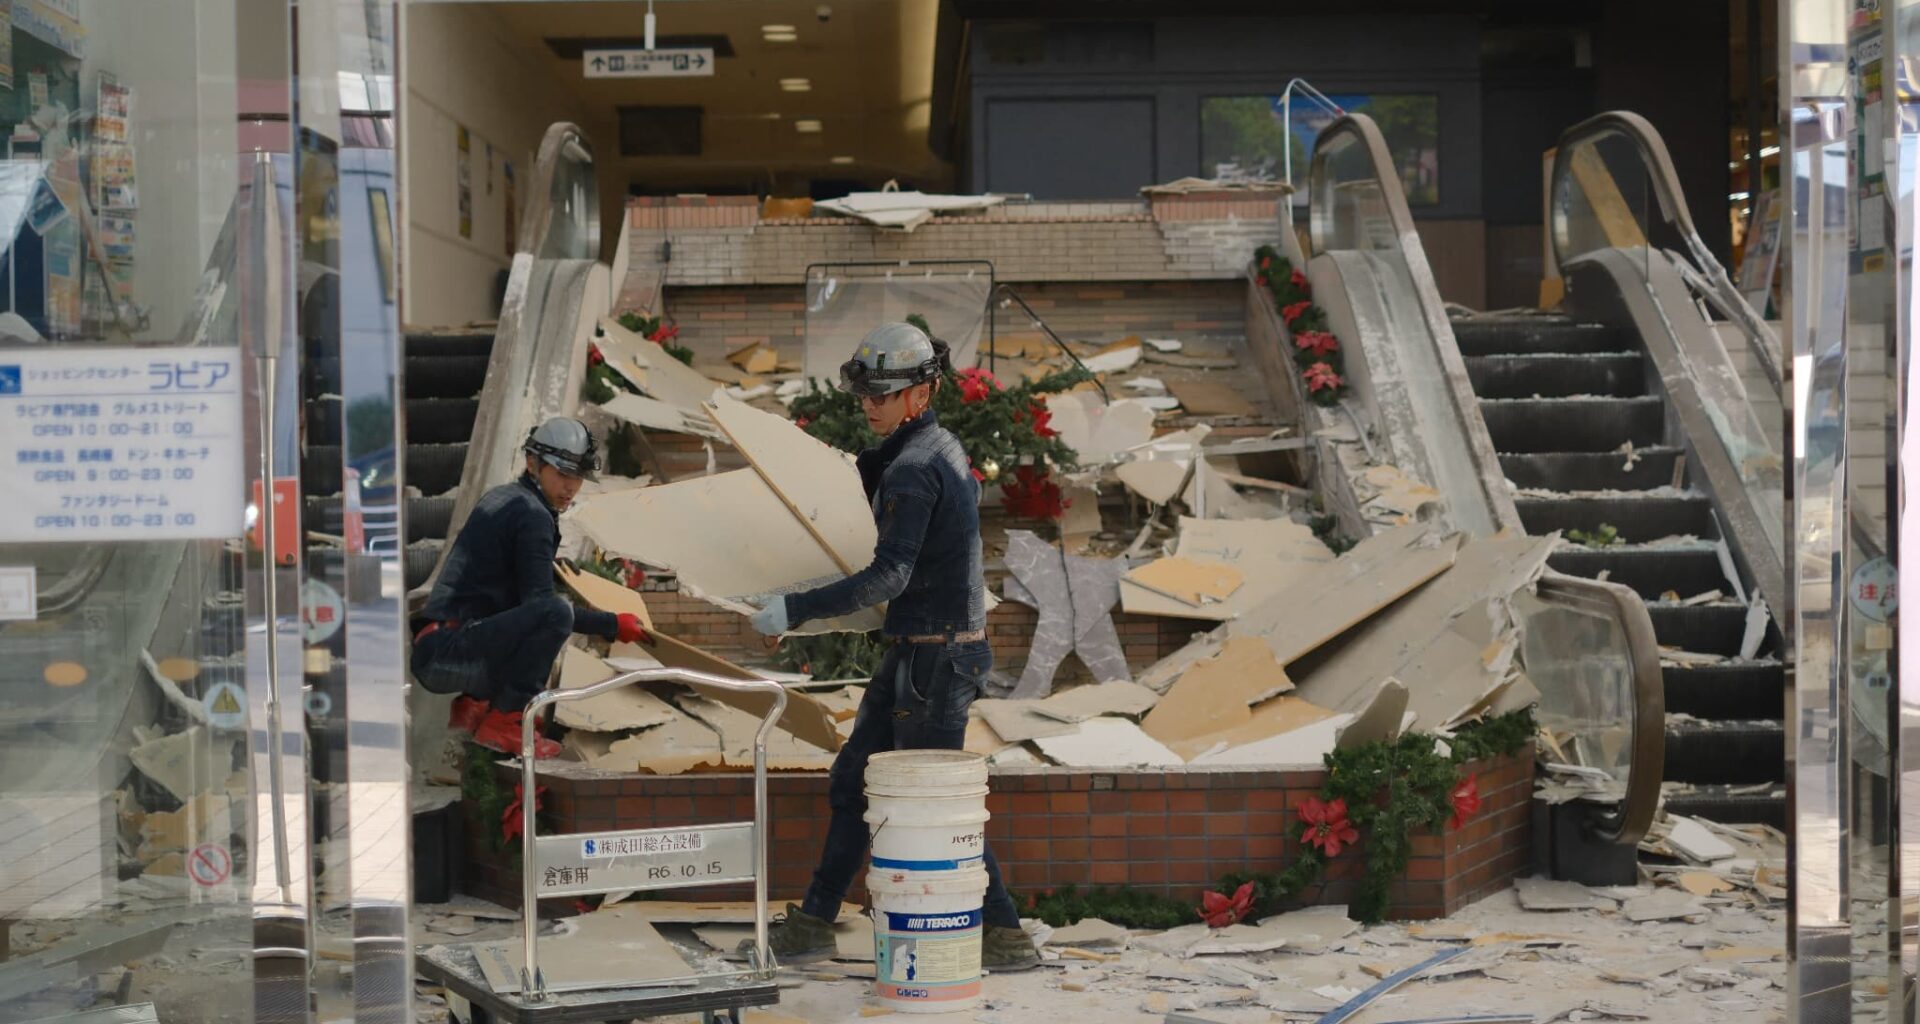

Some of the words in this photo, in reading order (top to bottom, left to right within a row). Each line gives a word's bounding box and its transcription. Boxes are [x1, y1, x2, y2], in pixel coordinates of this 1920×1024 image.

[149, 361, 230, 390] ラピア
[113, 402, 209, 416] グルメストリート
[33, 424, 73, 437] OPEN
[35, 469, 75, 482] OPEN
[35, 515, 75, 528] OPEN
[542, 866, 590, 887] 倉庫用
[925, 914, 970, 929] TERRACO
